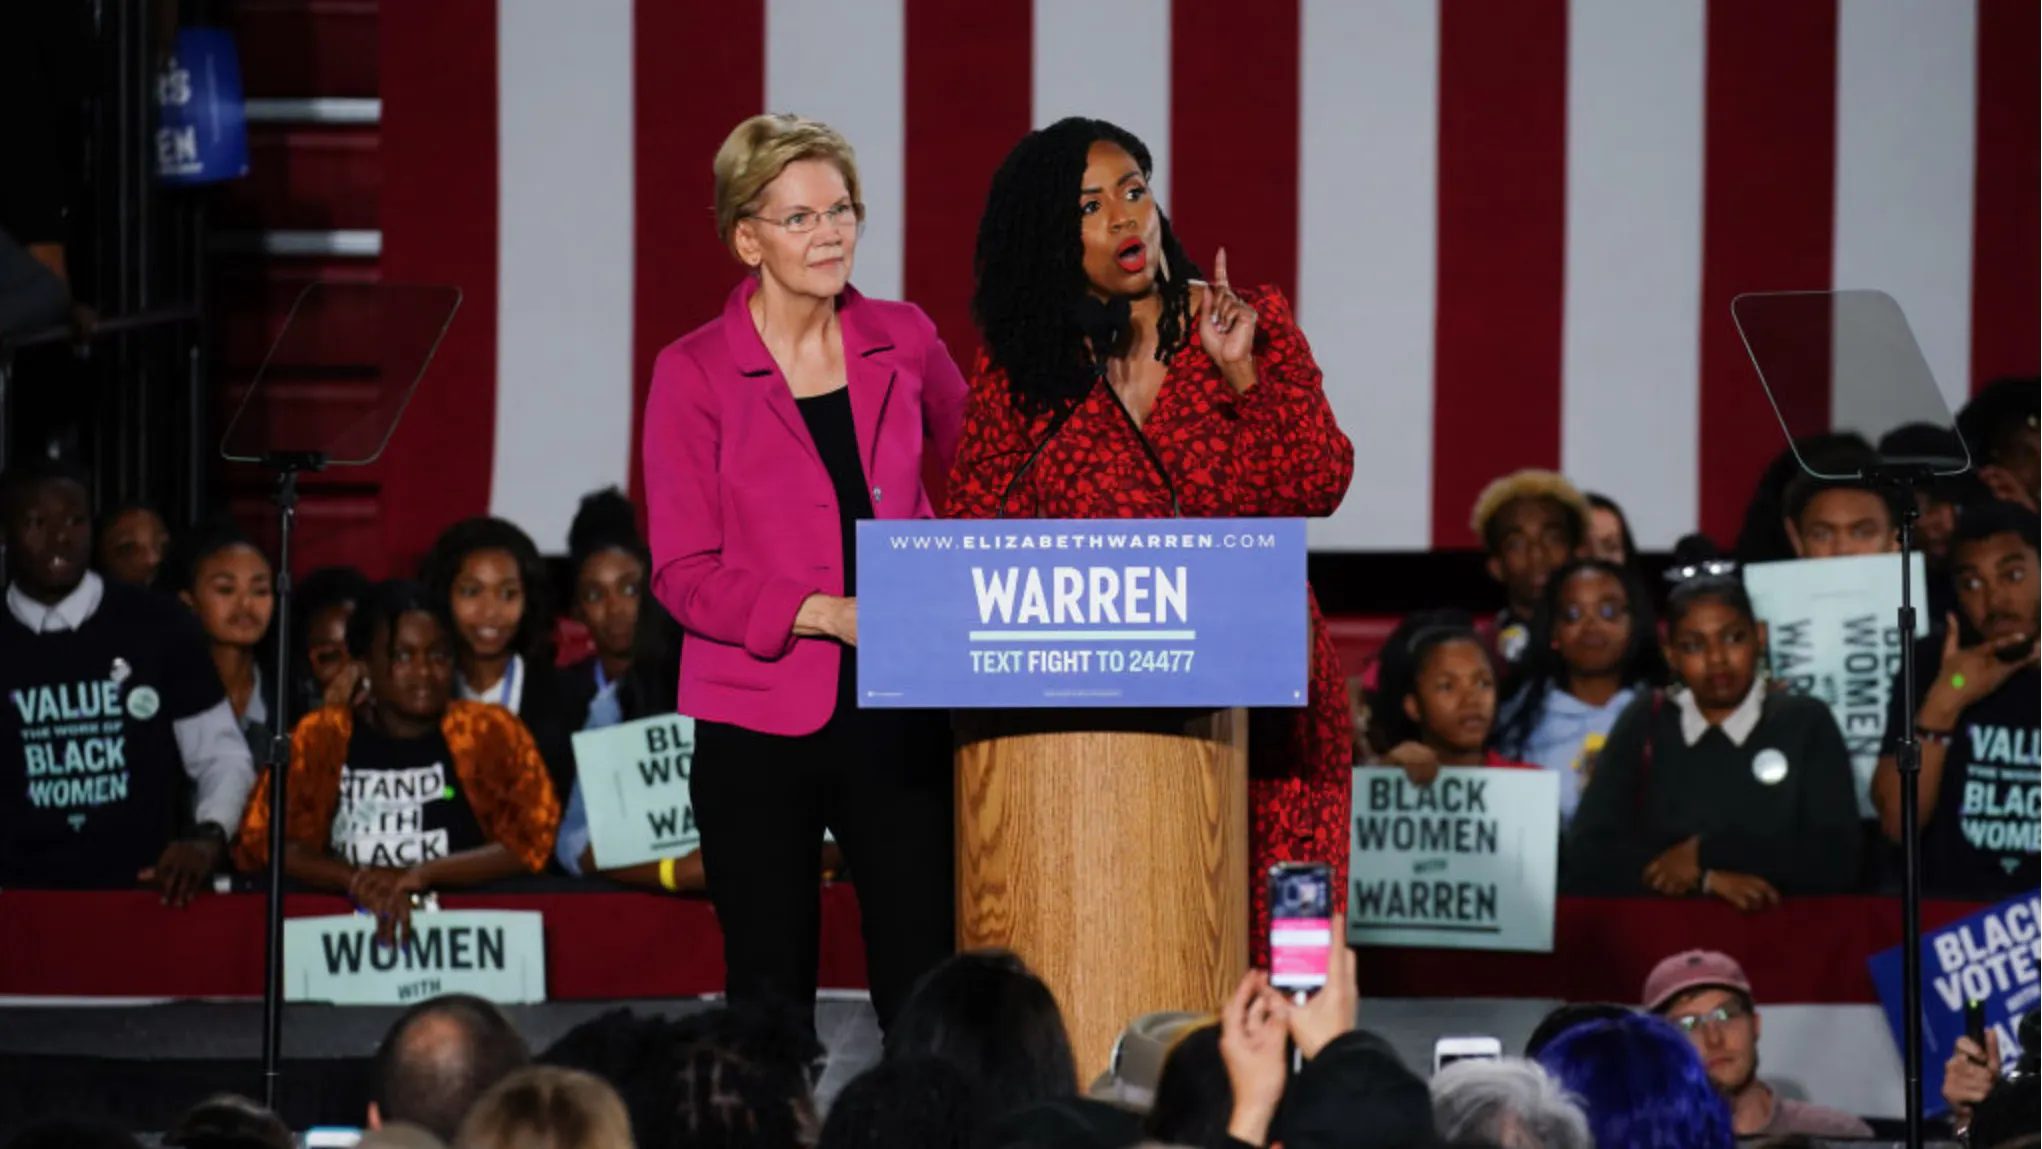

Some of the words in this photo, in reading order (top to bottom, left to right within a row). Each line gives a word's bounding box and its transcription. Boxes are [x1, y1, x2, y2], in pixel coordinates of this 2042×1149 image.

[889, 534, 1276, 550] WWW.ELIZABETHWARREN.COM
[971, 566, 1188, 625] WARREN
[969, 650, 1024, 674] TEXT
[1027, 650, 1093, 674] FIGHT
[1096, 650, 1125, 673] TO
[1128, 650, 1195, 673] 24477
[15, 680, 123, 724] VALUE
[1844, 613, 1883, 758] WOMEN
[24, 735, 126, 776] BLACK
[28, 771, 129, 808] WOMEN
[1368, 777, 1487, 813] BLACK
[1356, 815, 1498, 854] WOMEN
[1355, 878, 1498, 921] WARREN
[321, 925, 505, 975] WOMEN
[397, 977, 442, 1000] WITH
